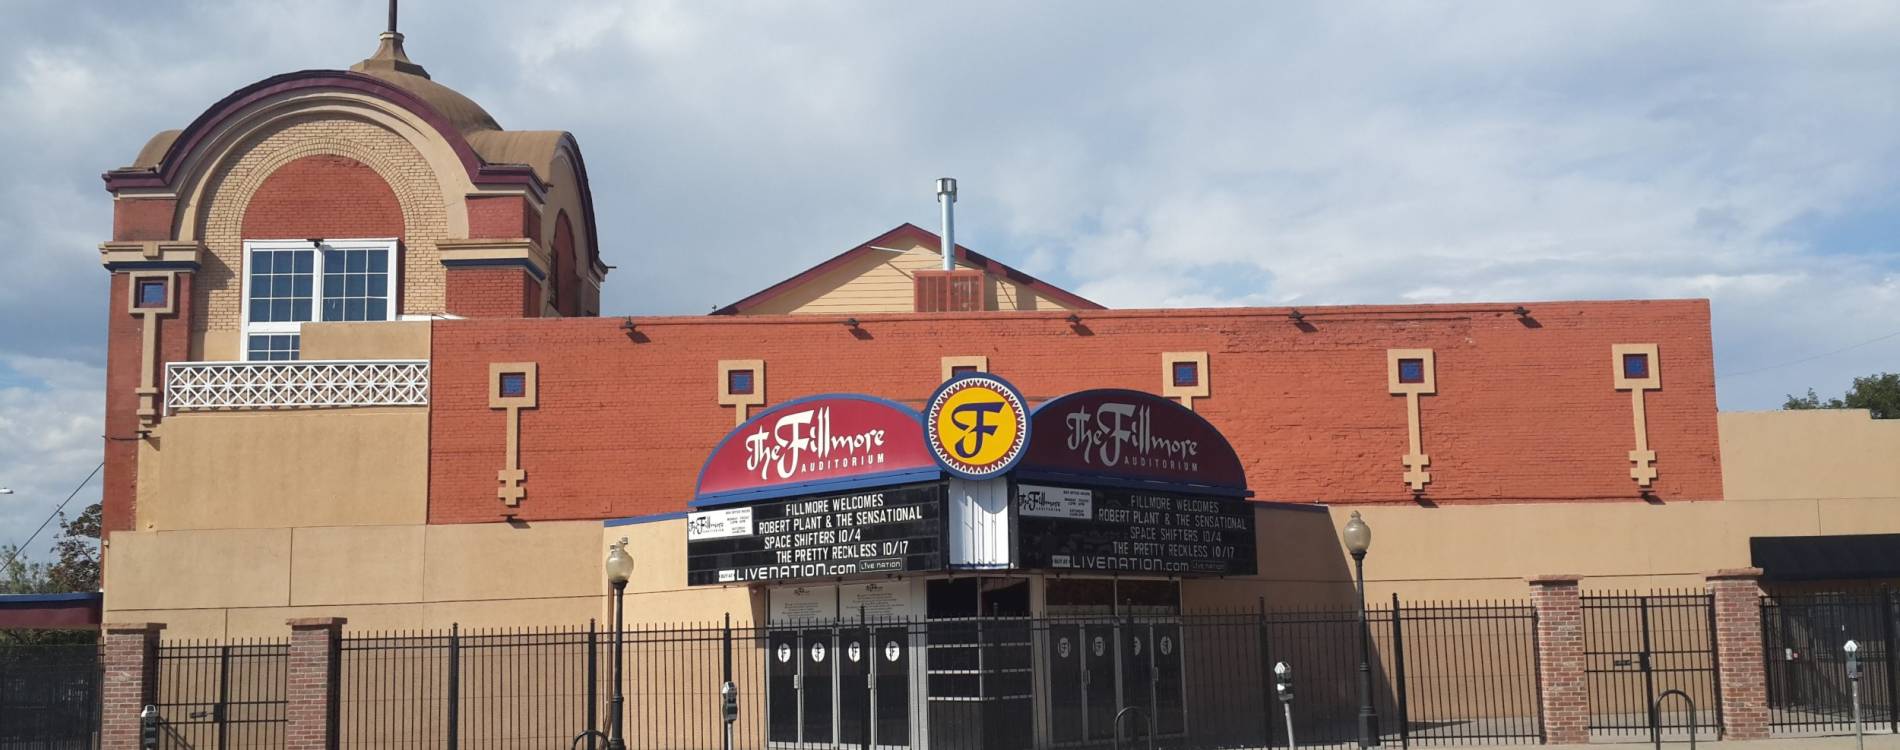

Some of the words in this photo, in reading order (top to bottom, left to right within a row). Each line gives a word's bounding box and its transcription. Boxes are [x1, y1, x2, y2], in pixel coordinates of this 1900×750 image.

[950, 401, 1006, 456] F
[1066, 404, 1101, 463] The
[1097, 402, 1198, 467] Fillmore
[745, 425, 780, 479] The
[775, 405, 885, 479] Fillmore
[801, 452, 885, 473] AUDITORIUM
[1124, 455, 1198, 472] AUDITORIUM
[785, 499, 829, 516] FILLMORE
[832, 493, 884, 512] WELCOMES
[1130, 495, 1171, 511] FILLMORE
[1177, 499, 1220, 513] WELCOMES
[758, 520, 791, 535] ROBERT
[793, 516, 824, 531] PLANT
[825, 514, 832, 528] &
[836, 512, 853, 526] THE
[856, 506, 922, 524] SENSATIONAL
[1098, 508, 1130, 522] ROBERT
[1133, 510, 1159, 524] PLANT
[1164, 513, 1170, 525] &
[1176, 513, 1191, 526] THE
[1194, 514, 1247, 530] SENSATIONAL
[764, 534, 792, 550] SPACE
[794, 531, 836, 547] SHIFTERS
[838, 528, 861, 543] 10/4
[1130, 526, 1156, 539] SPACE
[1160, 528, 1198, 542] SHIFTERS
[1202, 530, 1221, 542] 10/4
[776, 550, 792, 564] THE
[794, 546, 828, 562] PRETTY
[832, 542, 878, 559] RECKLESS
[883, 541, 909, 555] 10/17
[1112, 541, 1129, 555] THE
[1133, 542, 1165, 556] PRETTY
[1168, 544, 1208, 558] RECKLESS
[1212, 546, 1235, 559] 10/17
